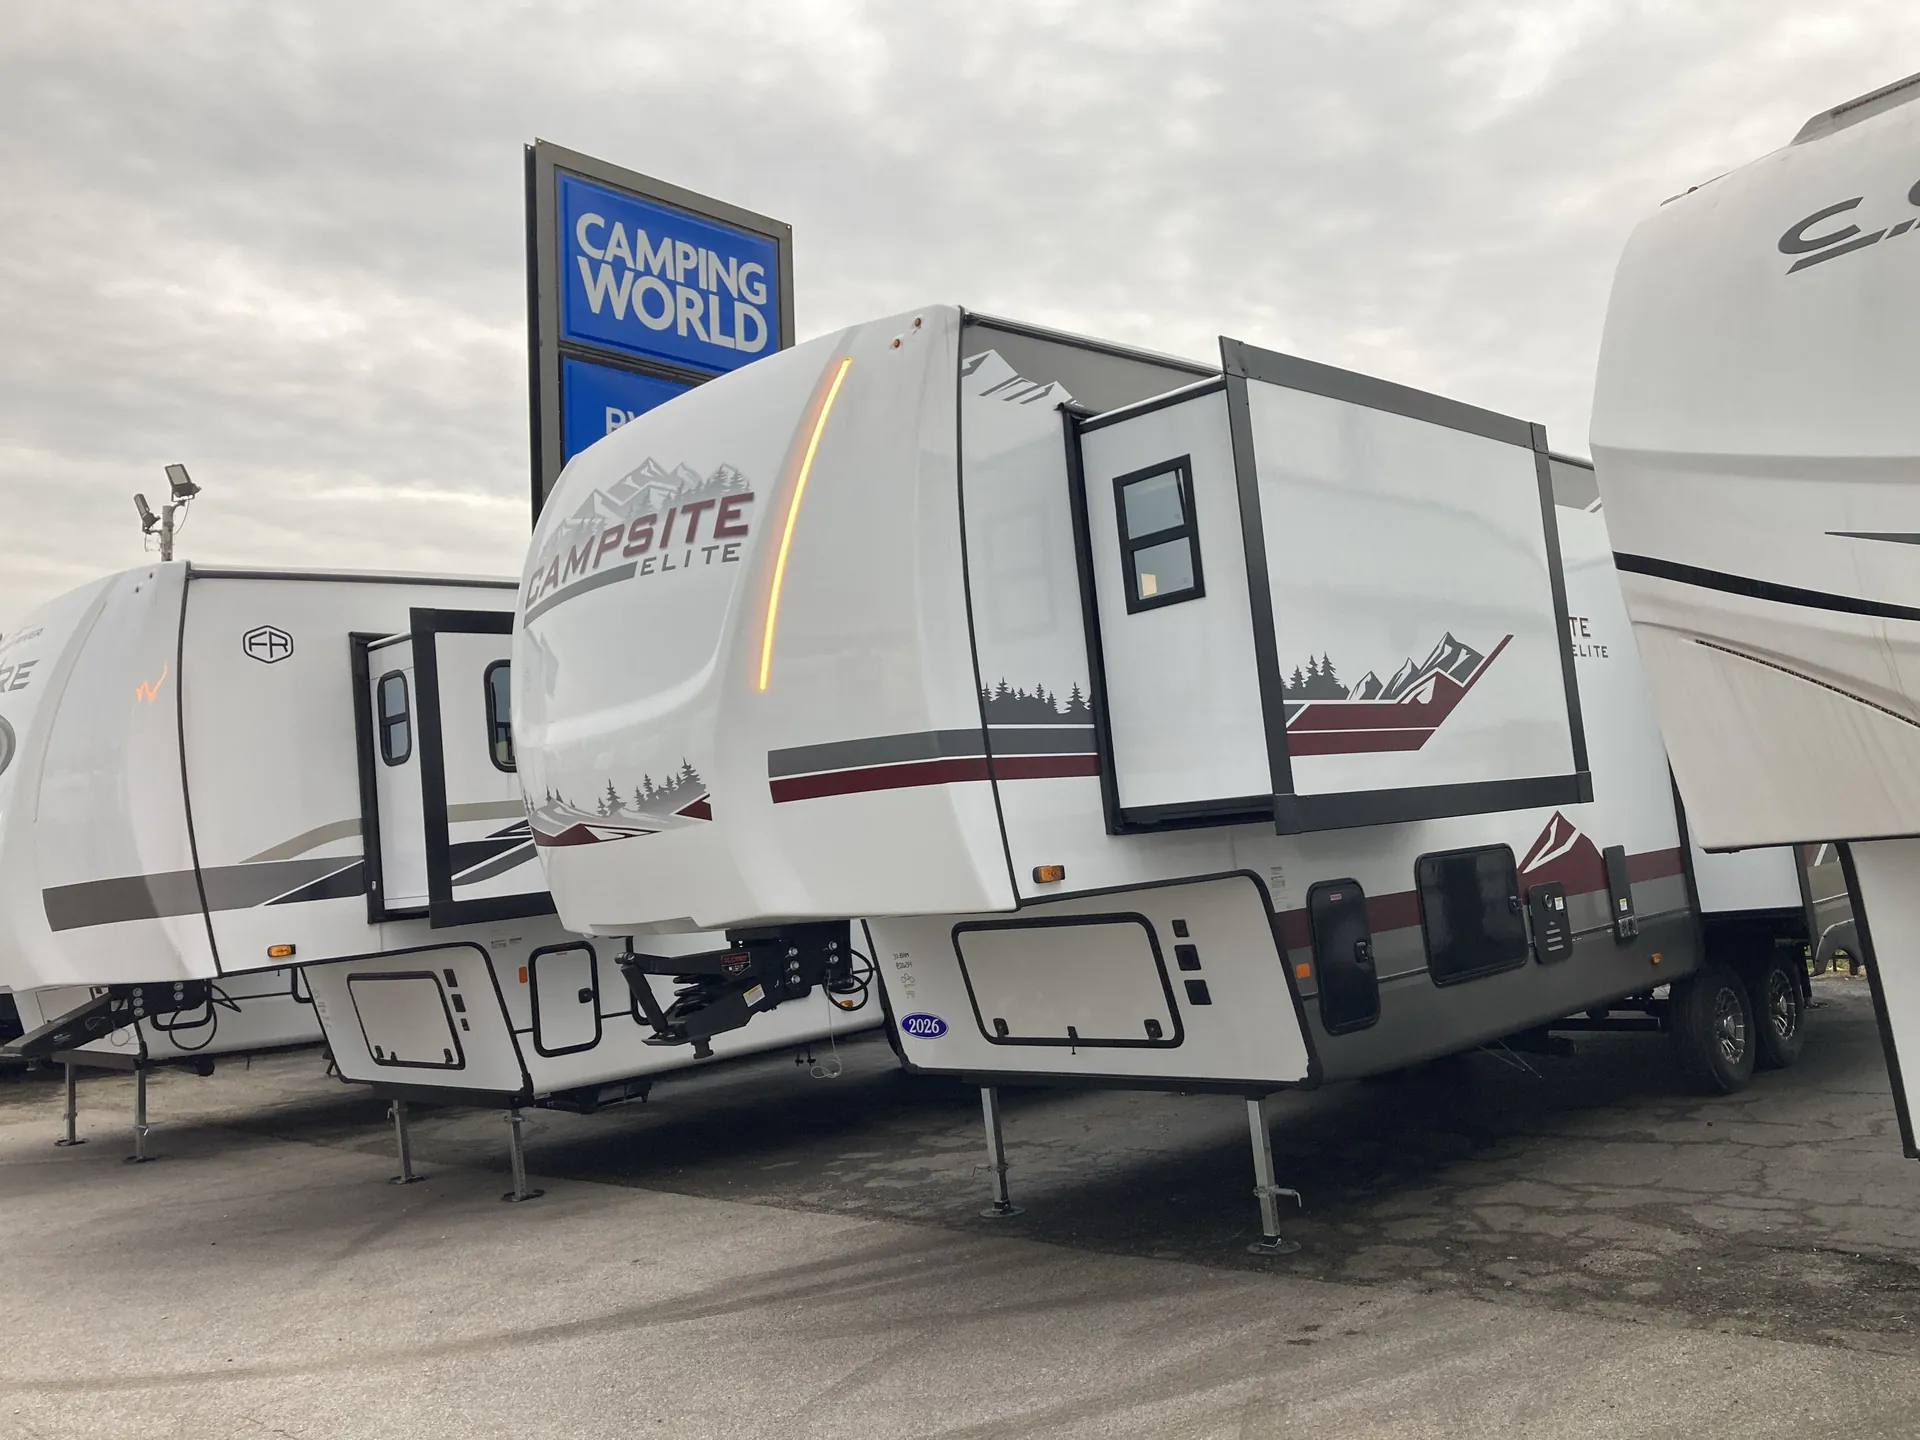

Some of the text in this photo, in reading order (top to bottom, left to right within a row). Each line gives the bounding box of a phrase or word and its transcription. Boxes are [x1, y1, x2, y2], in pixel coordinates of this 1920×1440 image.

[575, 212, 767, 305] CAMPING
[576, 255, 768, 353] WORLD
[605, 406, 636, 436] R
[525, 491, 755, 611] CAMPSITE
[639, 542, 742, 576] ELITE
[1571, 643, 1609, 659] ELITE
[908, 1018, 940, 1034] 2026
